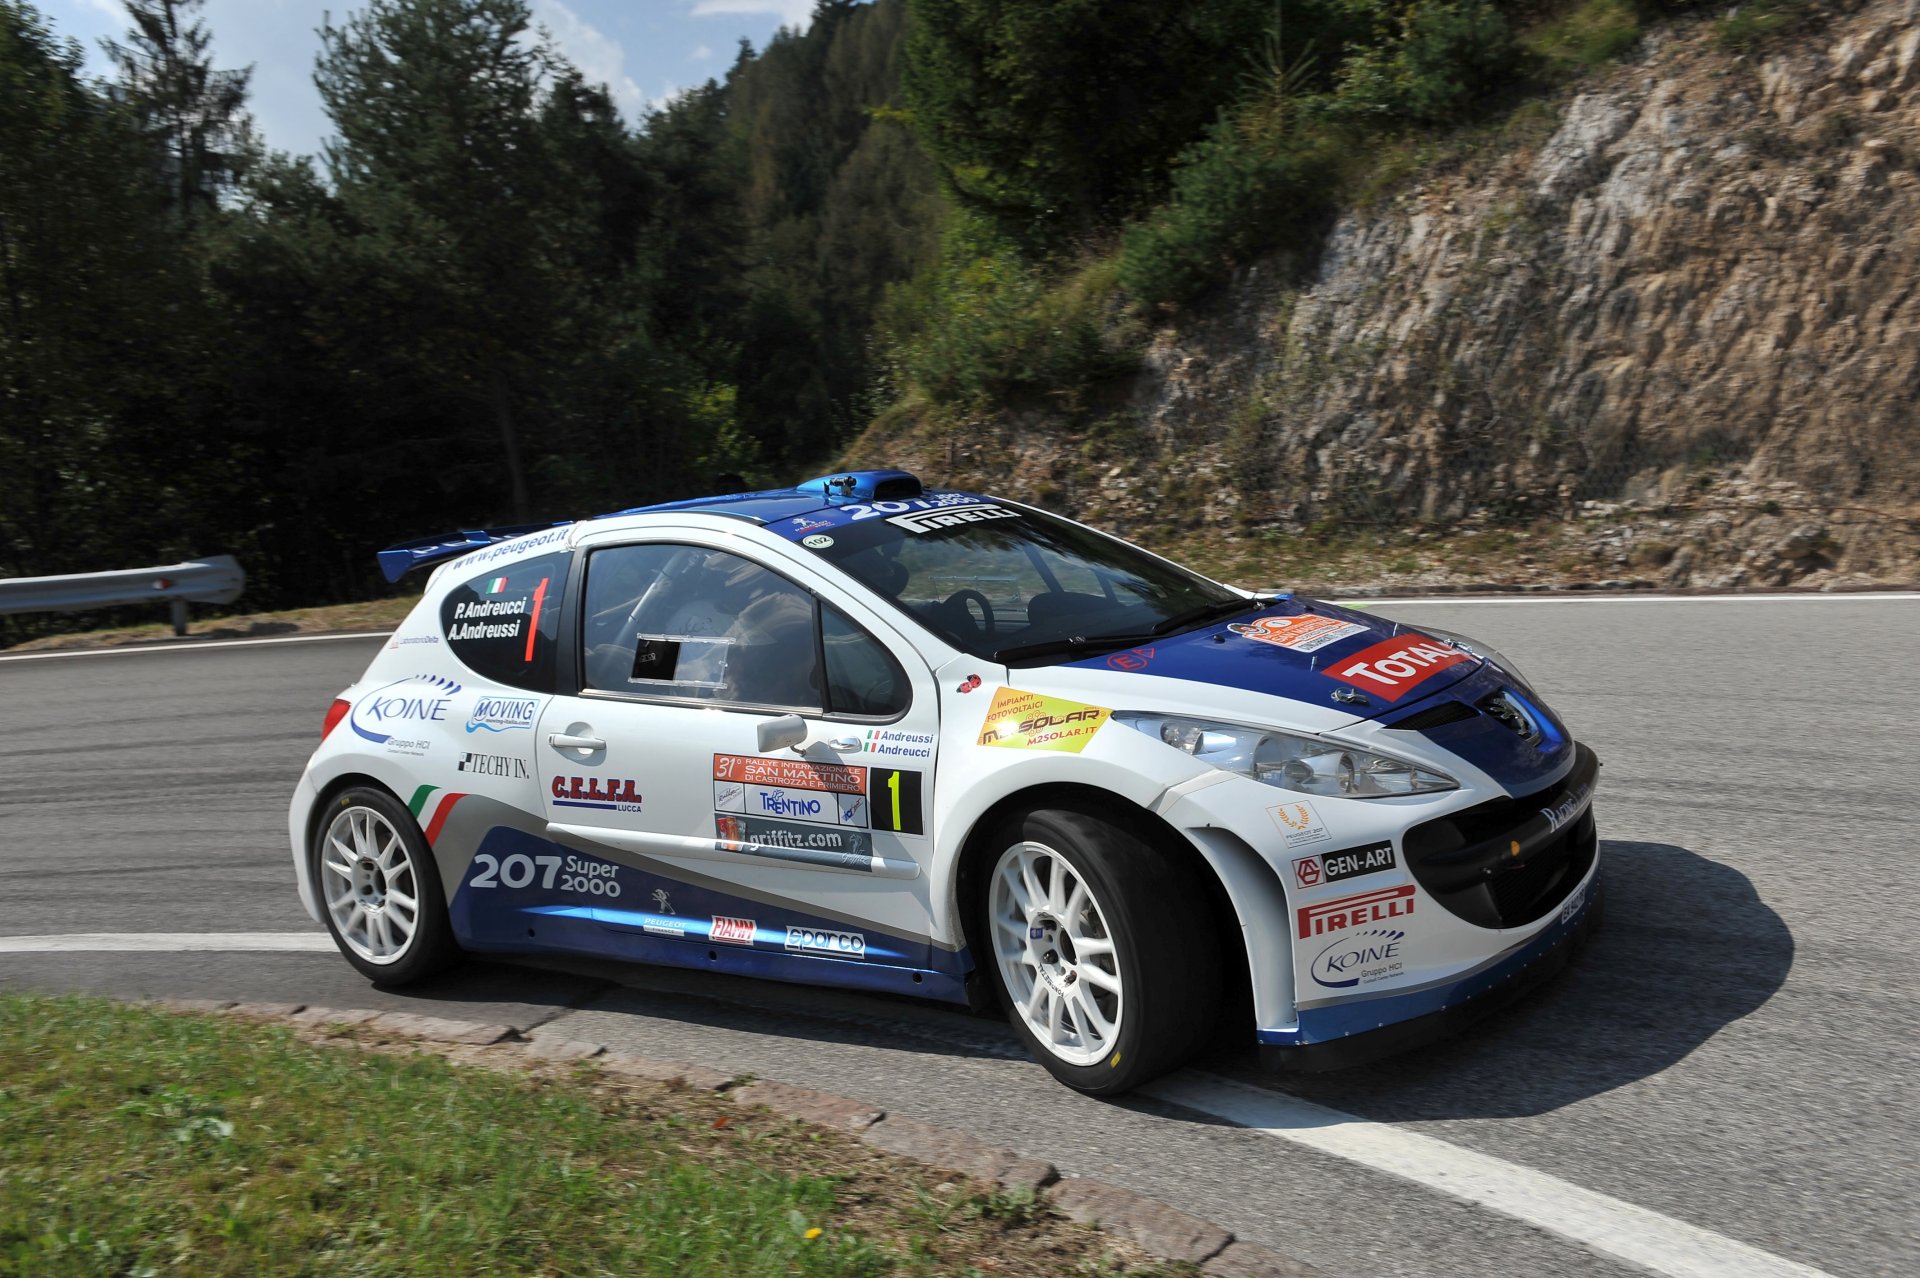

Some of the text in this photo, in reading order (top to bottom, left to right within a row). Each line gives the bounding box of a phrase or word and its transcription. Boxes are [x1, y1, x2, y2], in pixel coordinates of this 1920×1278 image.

[886, 503, 1022, 534] PIRELLI
[453, 528, 569, 570] www.peugeot.it
[454, 597, 527, 619] P.Andreucci
[525, 577, 549, 661] 1
[448, 620, 521, 640] A.Andreussi
[1341, 643, 1461, 685] TOTAL
[474, 700, 534, 720] MOVING
[987, 701, 1043, 722] FOTOVOLTAICI
[997, 694, 1034, 708] IMPIANTI
[881, 730, 934, 744] Andreussi
[877, 744, 930, 757] Andreucci
[472, 753, 511, 776] TECHY
[745, 759, 861, 775] RALLYE INTERNAZIONALE
[745, 766, 861, 784] SAN MARTINO
[552, 776, 642, 803] C.E.L.F.A.
[755, 775, 807, 787] CASTROZZA
[817, 782, 861, 792] PRIMIERO
[617, 805, 641, 813] LUCCA
[760, 792, 821, 816] TRENTINO
[887, 771, 901, 830] 1
[749, 829, 842, 852] griffitz.com
[469, 853, 562, 889] 207
[565, 855, 619, 878] Super
[1325, 847, 1392, 876] GEN-ART
[560, 875, 621, 897] 2000
[644, 917, 688, 928] PEUGEOT
[1297, 885, 1416, 939] PIRELLI
[713, 917, 754, 939] FIAMM
[788, 928, 864, 951] sparco
